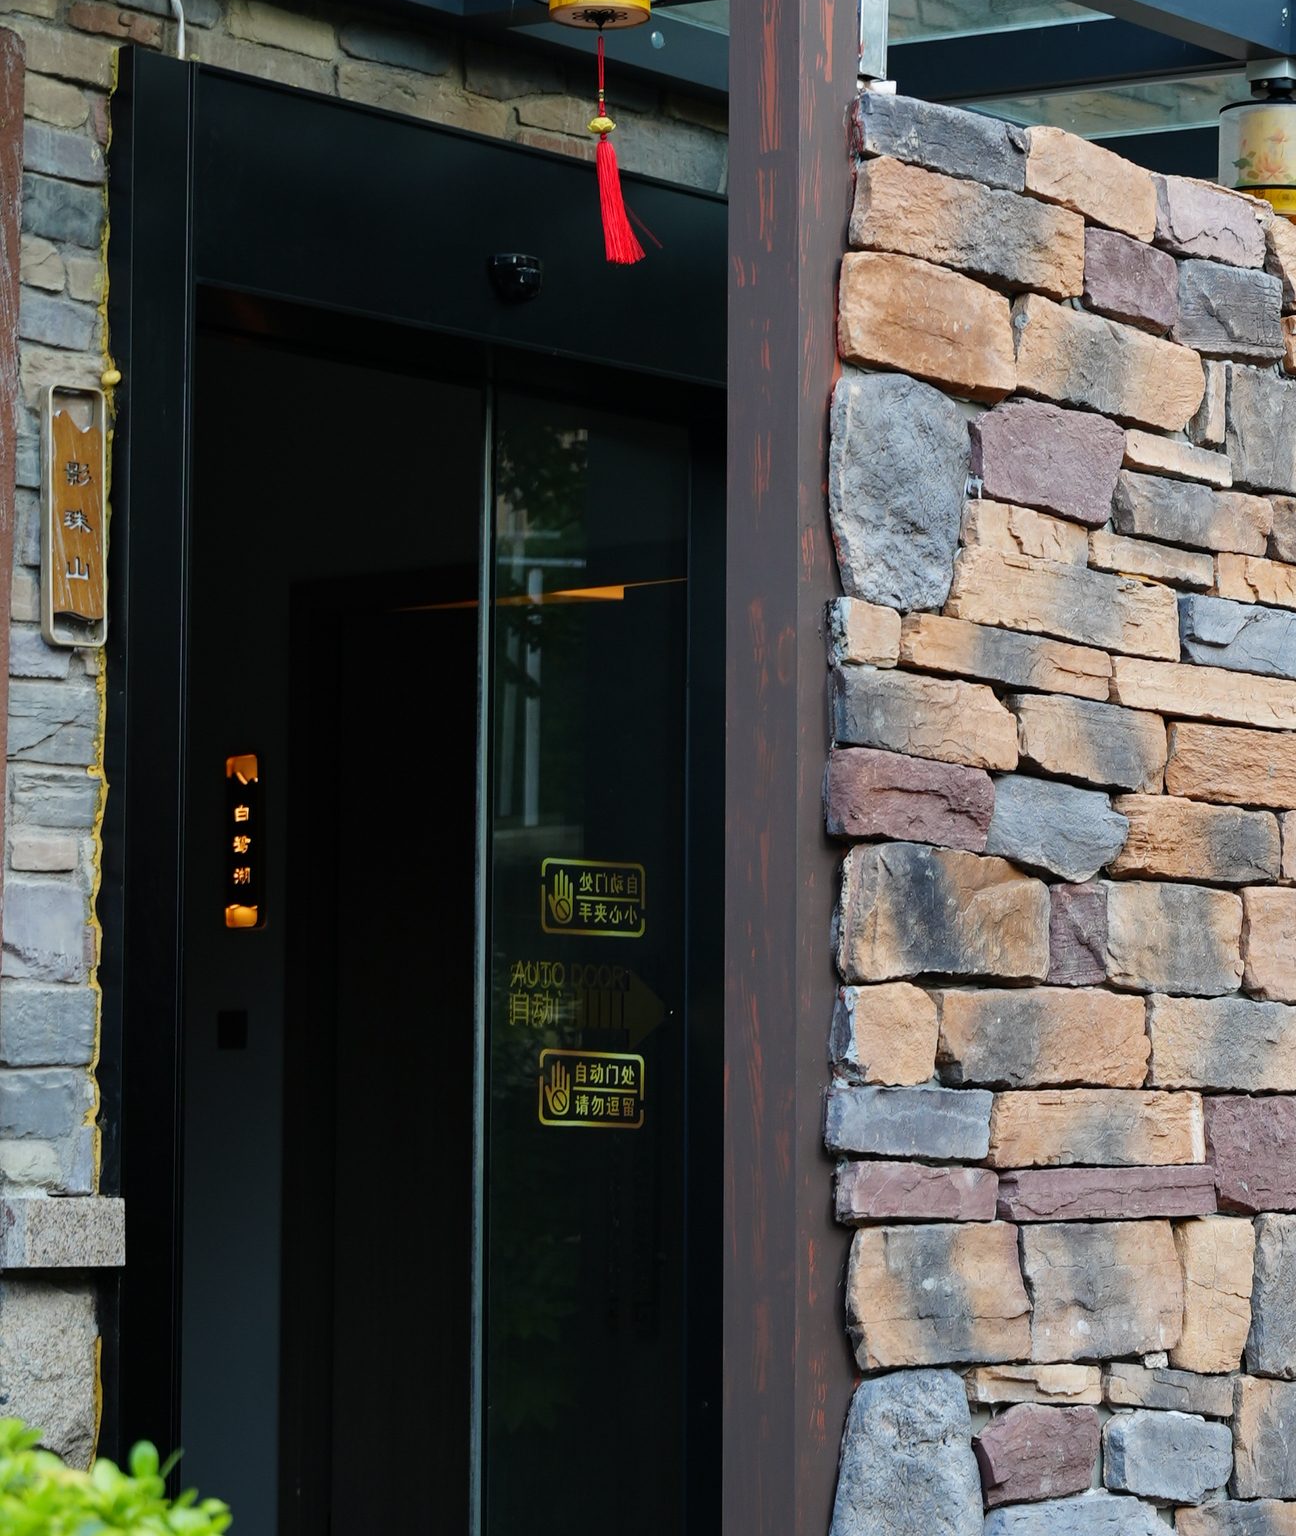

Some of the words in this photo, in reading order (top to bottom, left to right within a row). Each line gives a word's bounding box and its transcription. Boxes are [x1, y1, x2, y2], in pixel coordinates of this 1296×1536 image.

[64, 461, 93, 581] 影珠山
[510, 960, 565, 990] AUTO
[574, 1061, 636, 1086] 自动门处
[574, 1094, 636, 1117] 请勿逗留
